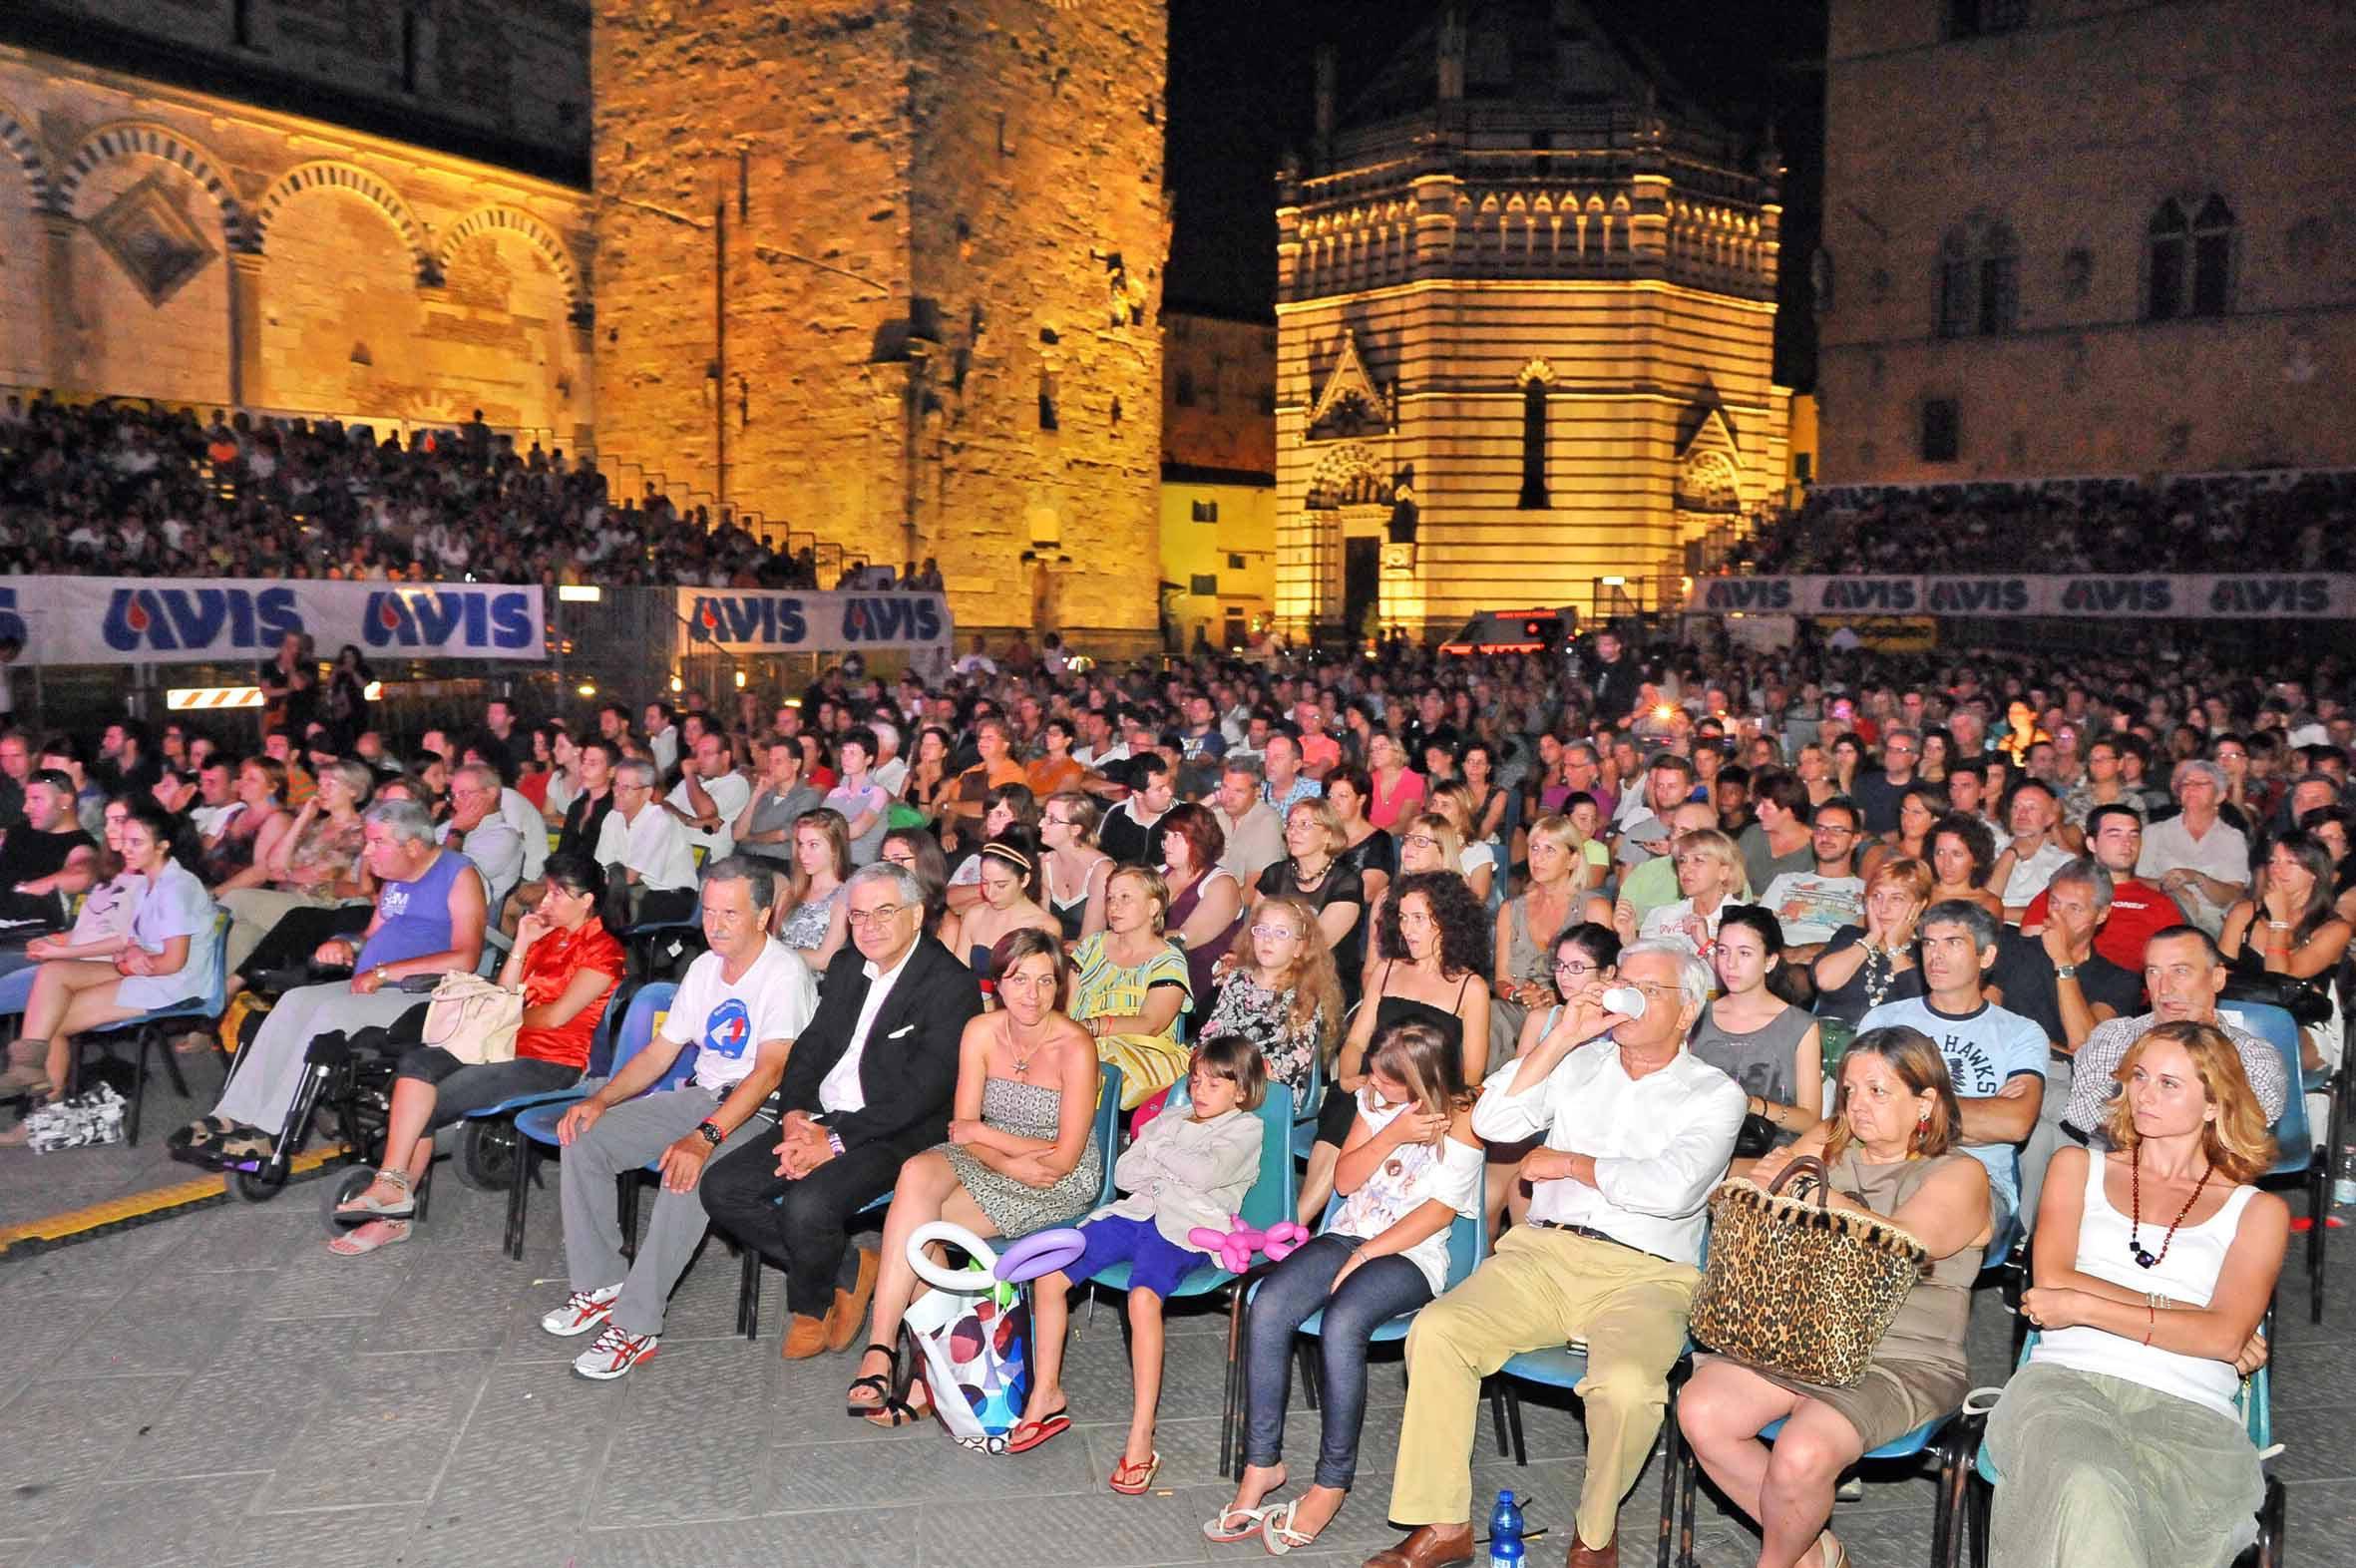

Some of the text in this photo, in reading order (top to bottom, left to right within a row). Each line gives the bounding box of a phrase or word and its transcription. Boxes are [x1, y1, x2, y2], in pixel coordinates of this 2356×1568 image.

[1707, 581, 1791, 609] AVIS
[1822, 581, 1917, 609] AVIS
[1930, 580, 2029, 610] AVIS
[2061, 579, 2172, 610] AVIS
[2209, 579, 2330, 612] AVIS
[103, 588, 302, 651] AVIS
[363, 590, 533, 649] AVIS
[690, 596, 807, 643] AVIS
[842, 596, 942, 642] AVIS
